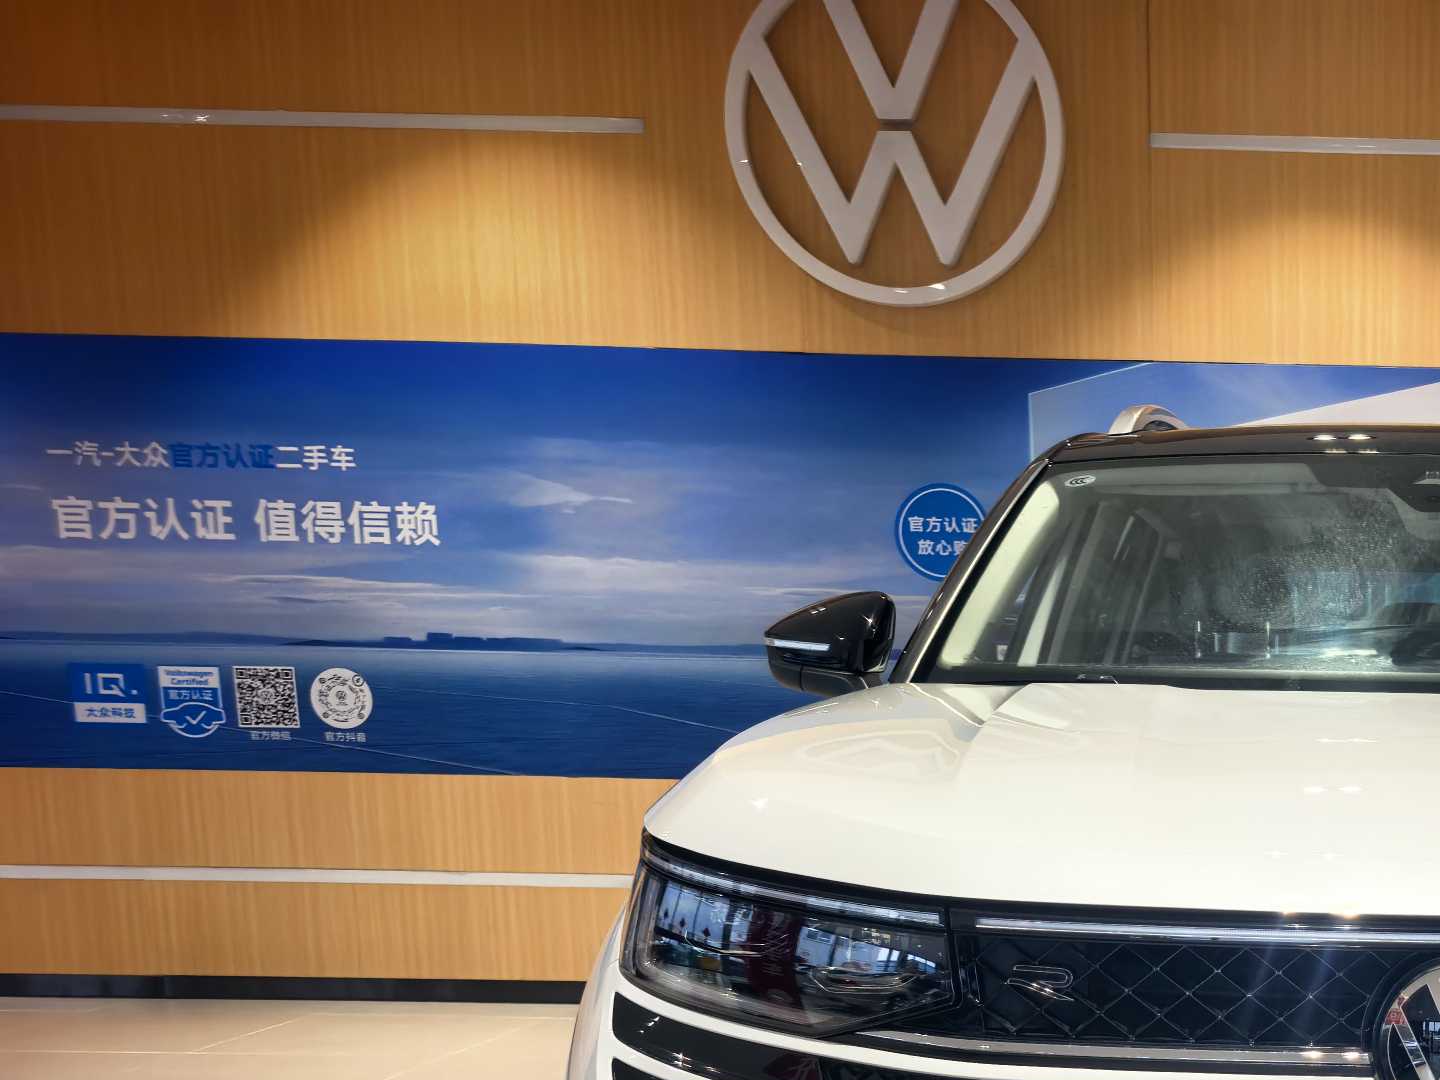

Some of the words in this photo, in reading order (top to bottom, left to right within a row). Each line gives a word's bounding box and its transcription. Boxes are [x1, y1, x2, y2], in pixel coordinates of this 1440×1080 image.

[46, 441, 357, 472] 一汽-大众官方认证二手车
[51, 496, 237, 541] 官方认证
[255, 498, 441, 546] 值得信赖
[908, 516, 978, 534] 官方认证
